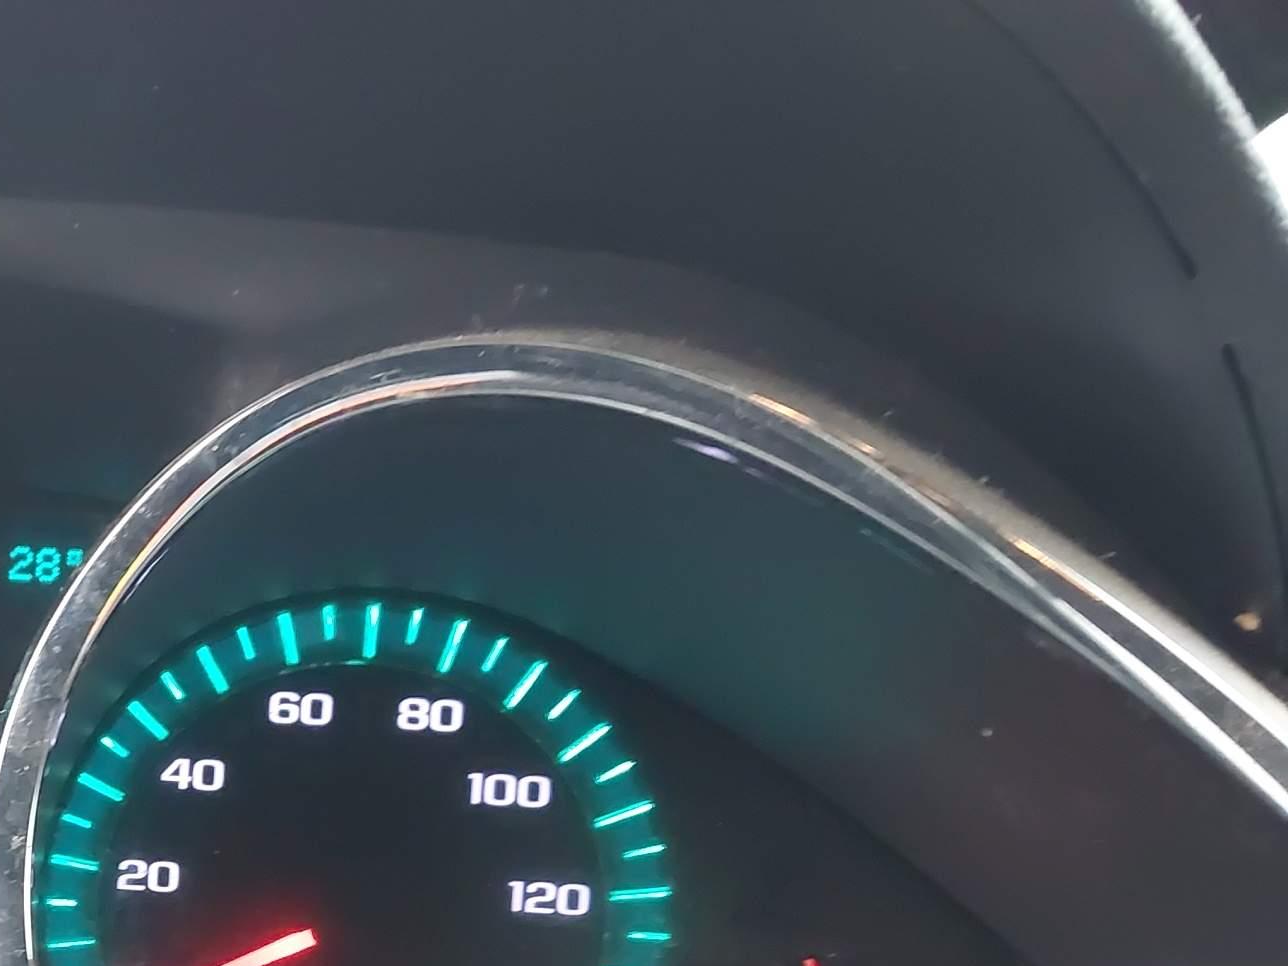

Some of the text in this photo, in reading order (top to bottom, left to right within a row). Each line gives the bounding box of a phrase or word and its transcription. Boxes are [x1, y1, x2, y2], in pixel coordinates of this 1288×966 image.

[268, 693, 334, 726] 60
[397, 698, 464, 733] 80
[160, 758, 225, 792] 40
[467, 773, 552, 809] 100
[116, 860, 179, 893] 20
[508, 881, 592, 917] 120
